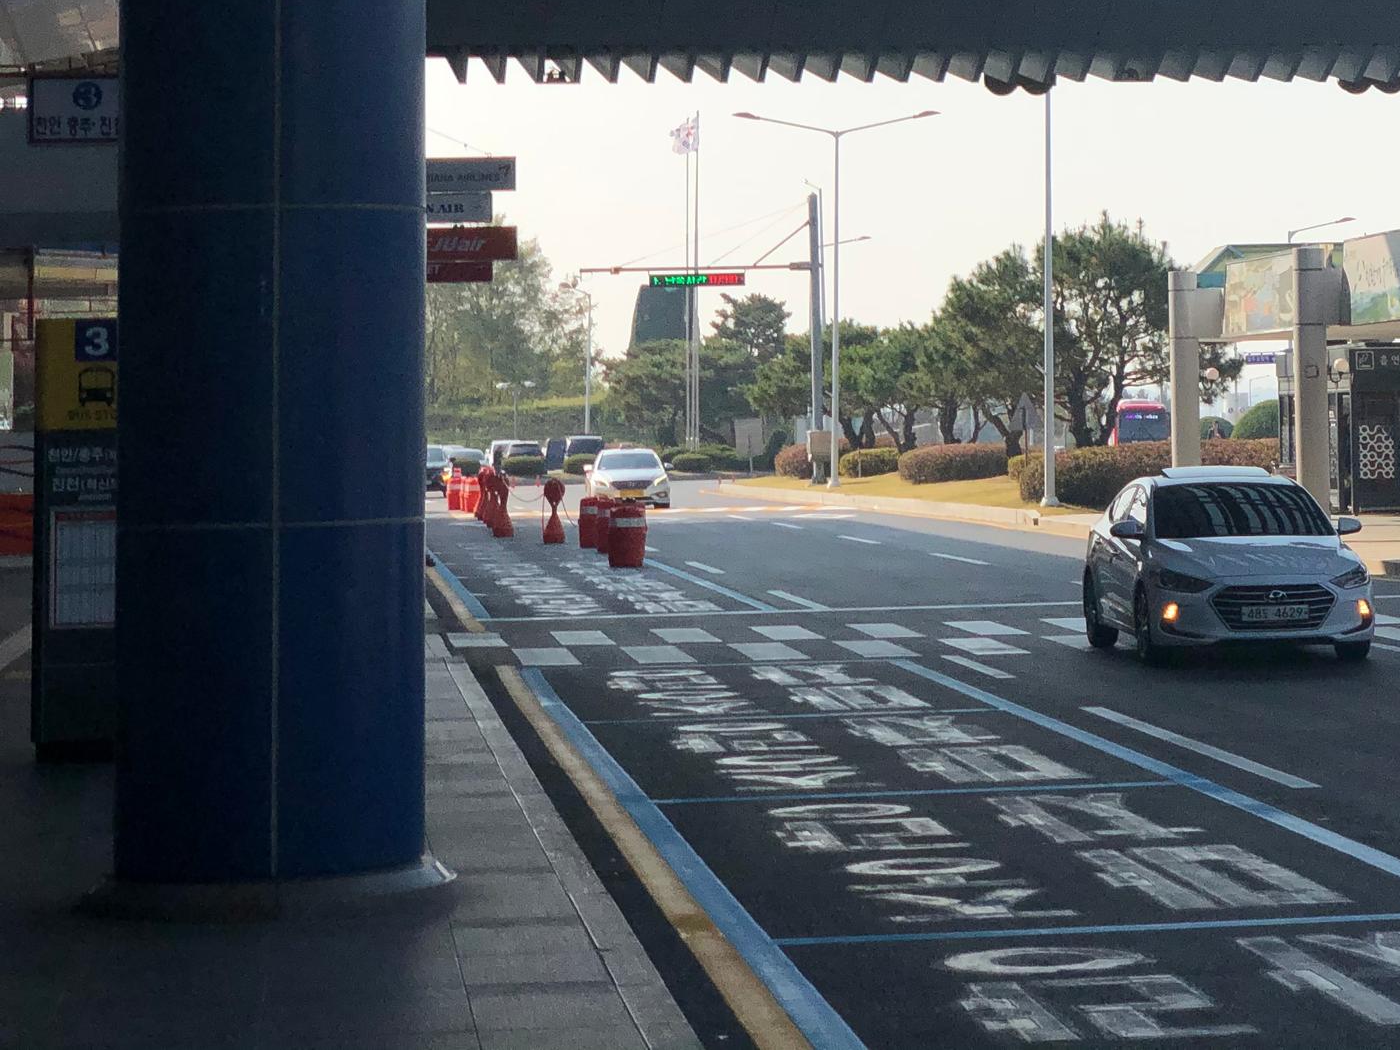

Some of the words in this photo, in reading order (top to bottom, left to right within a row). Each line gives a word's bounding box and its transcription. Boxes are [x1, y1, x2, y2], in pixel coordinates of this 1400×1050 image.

[439, 203, 465, 214] AIR
[427, 236, 487, 252] JUair
[84, 326, 109, 356] 3
[1274, 606, 1303, 618] 4629
